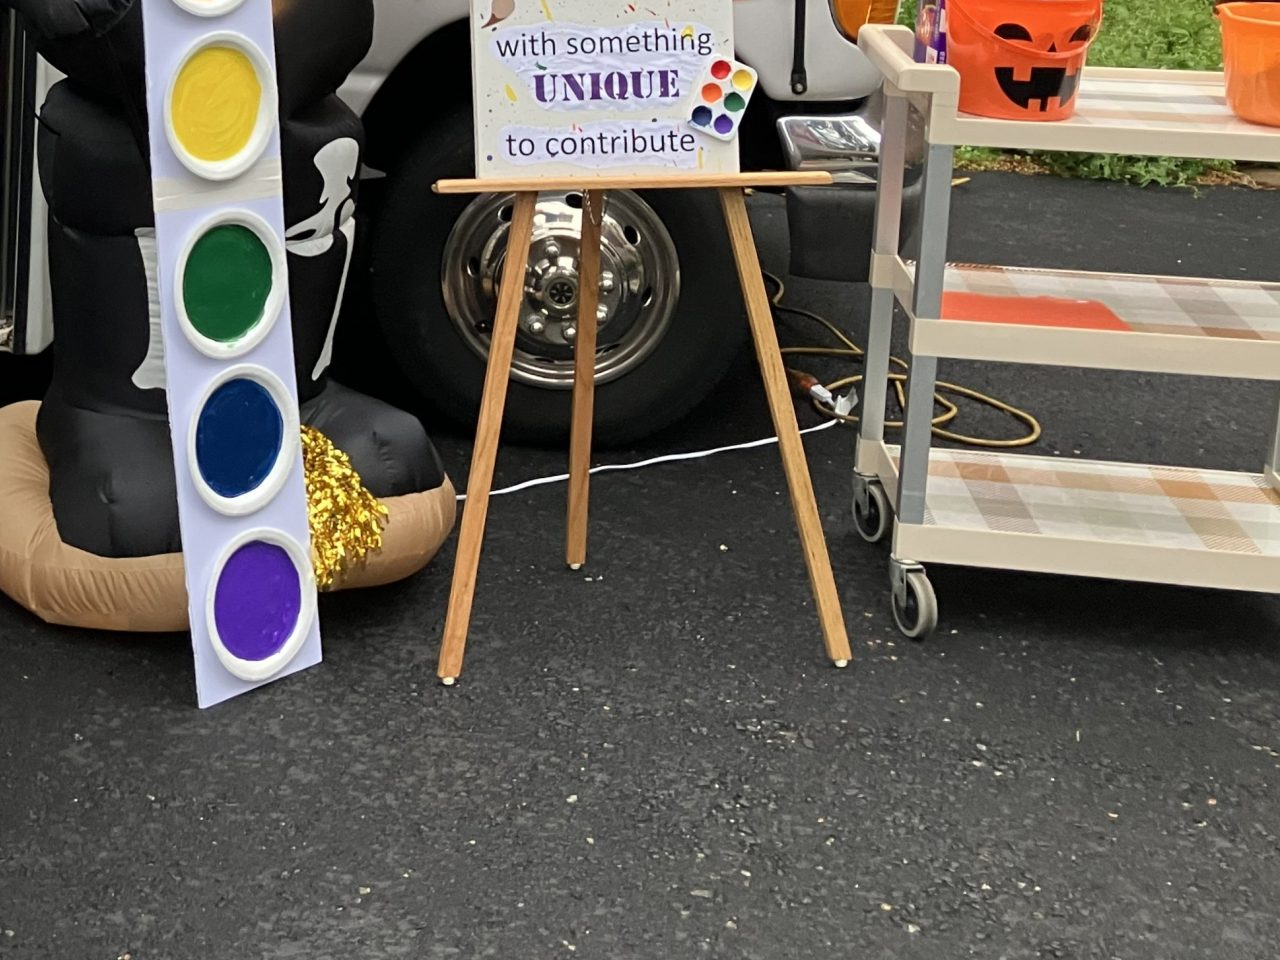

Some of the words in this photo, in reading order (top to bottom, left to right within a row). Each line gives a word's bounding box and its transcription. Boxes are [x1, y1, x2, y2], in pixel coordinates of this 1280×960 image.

[496, 31, 556, 57] with
[566, 28, 712, 56] something
[533, 70, 680, 103] UNIQUE
[506, 134, 535, 157] to
[546, 128, 695, 158] contribute
